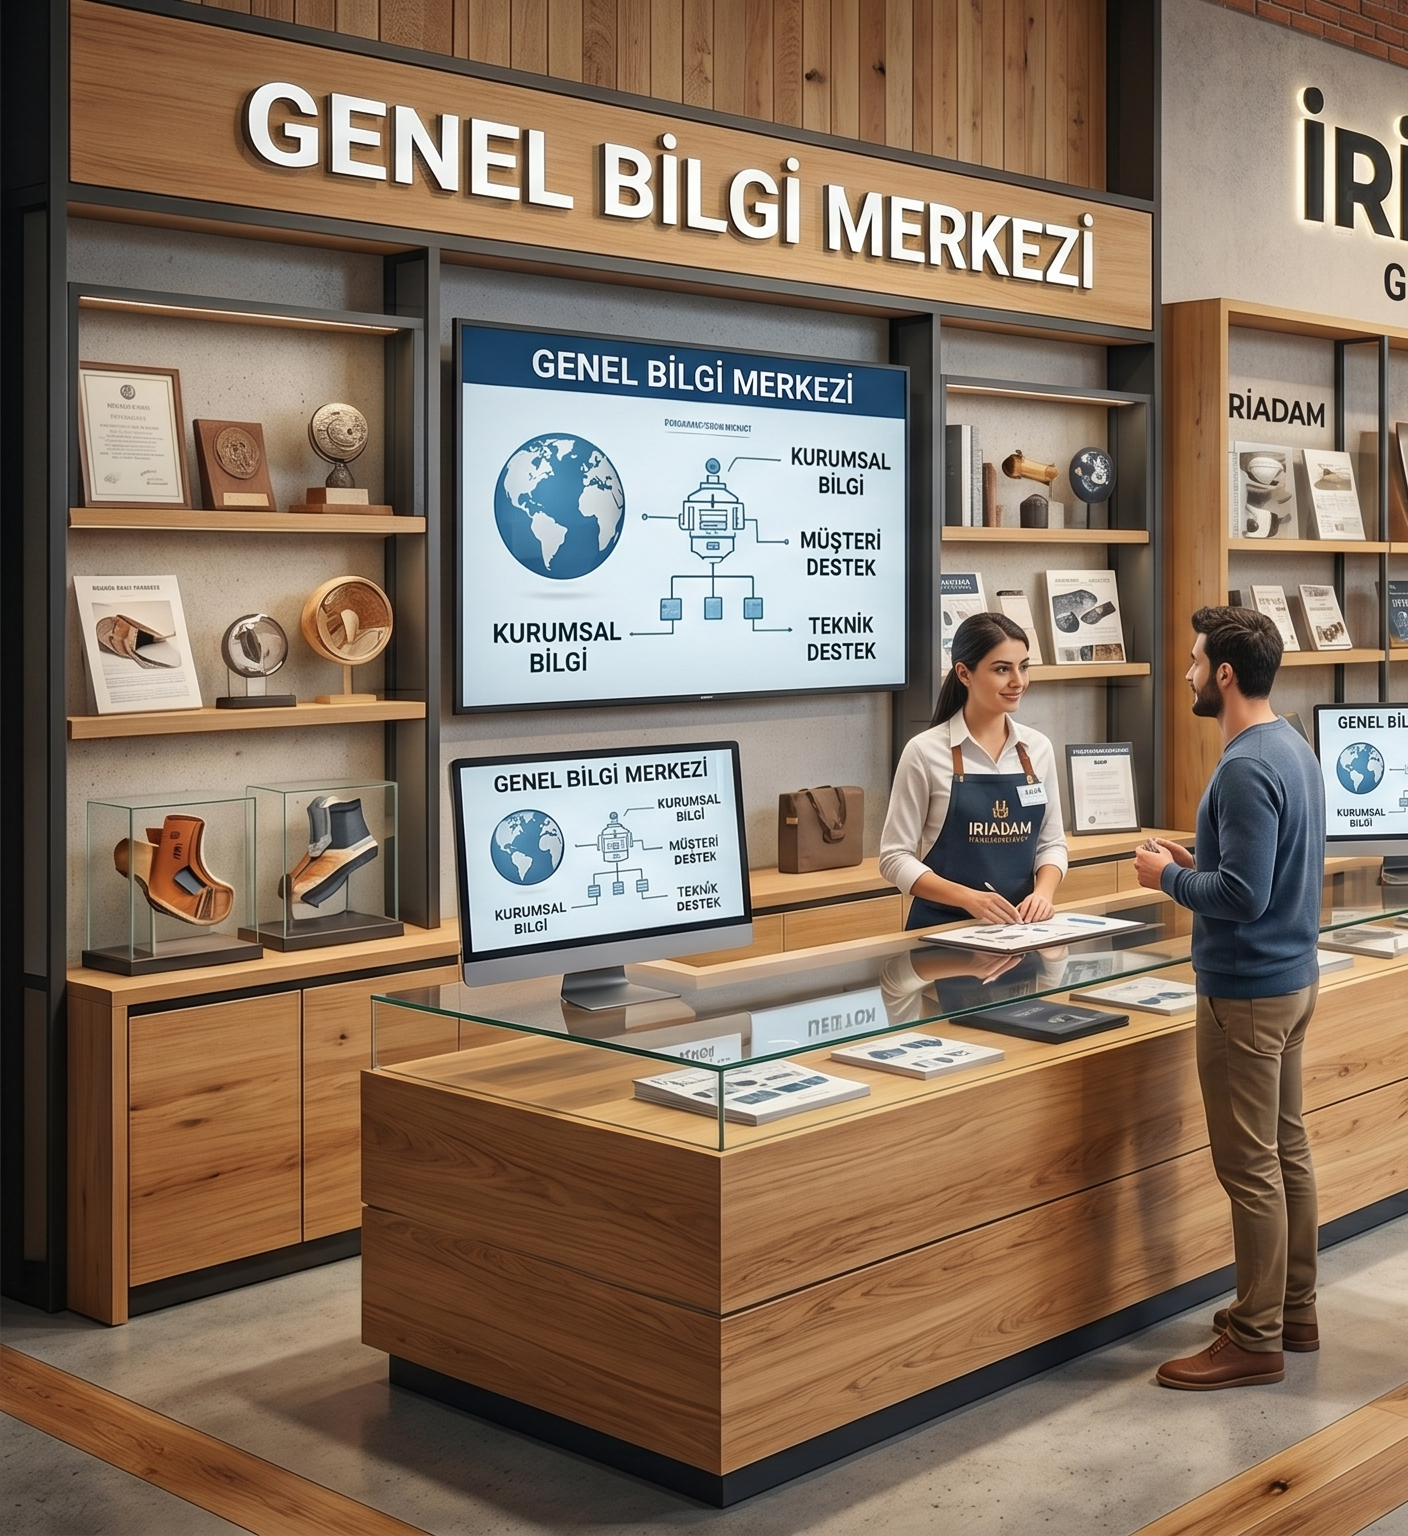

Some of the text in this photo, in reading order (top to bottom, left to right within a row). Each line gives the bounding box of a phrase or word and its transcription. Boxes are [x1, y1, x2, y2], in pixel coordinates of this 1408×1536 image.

[244, 81, 1095, 290] GENEL BİLGİ MERKEZİ
[532, 348, 853, 405] GENEL BİLGİ MERKEZİ
[791, 447, 891, 471] KURUMSAL
[819, 473, 864, 496] BİLGİ
[800, 528, 881, 554] MÜŞTERİ
[806, 558, 876, 577] DESTEK
[493, 621, 622, 645] KURUMSAL
[809, 611, 874, 635] TEKNİK
[529, 646, 588, 673] BİLGİ
[807, 642, 876, 662] DESTEK
[1338, 716, 1384, 729] GENEL
[494, 756, 708, 793] GENEL BİLGİ MERKEZİ
[657, 793, 721, 808] KURUMSAL
[1337, 808, 1386, 817] KURUMSAL
[969, 821, 1032, 835] IRIADAM
[674, 852, 717, 866] DESTEK
[677, 880, 718, 898] TEKNİK
[494, 902, 567, 921] KURUMSAL
[676, 897, 722, 912] DESTEK
